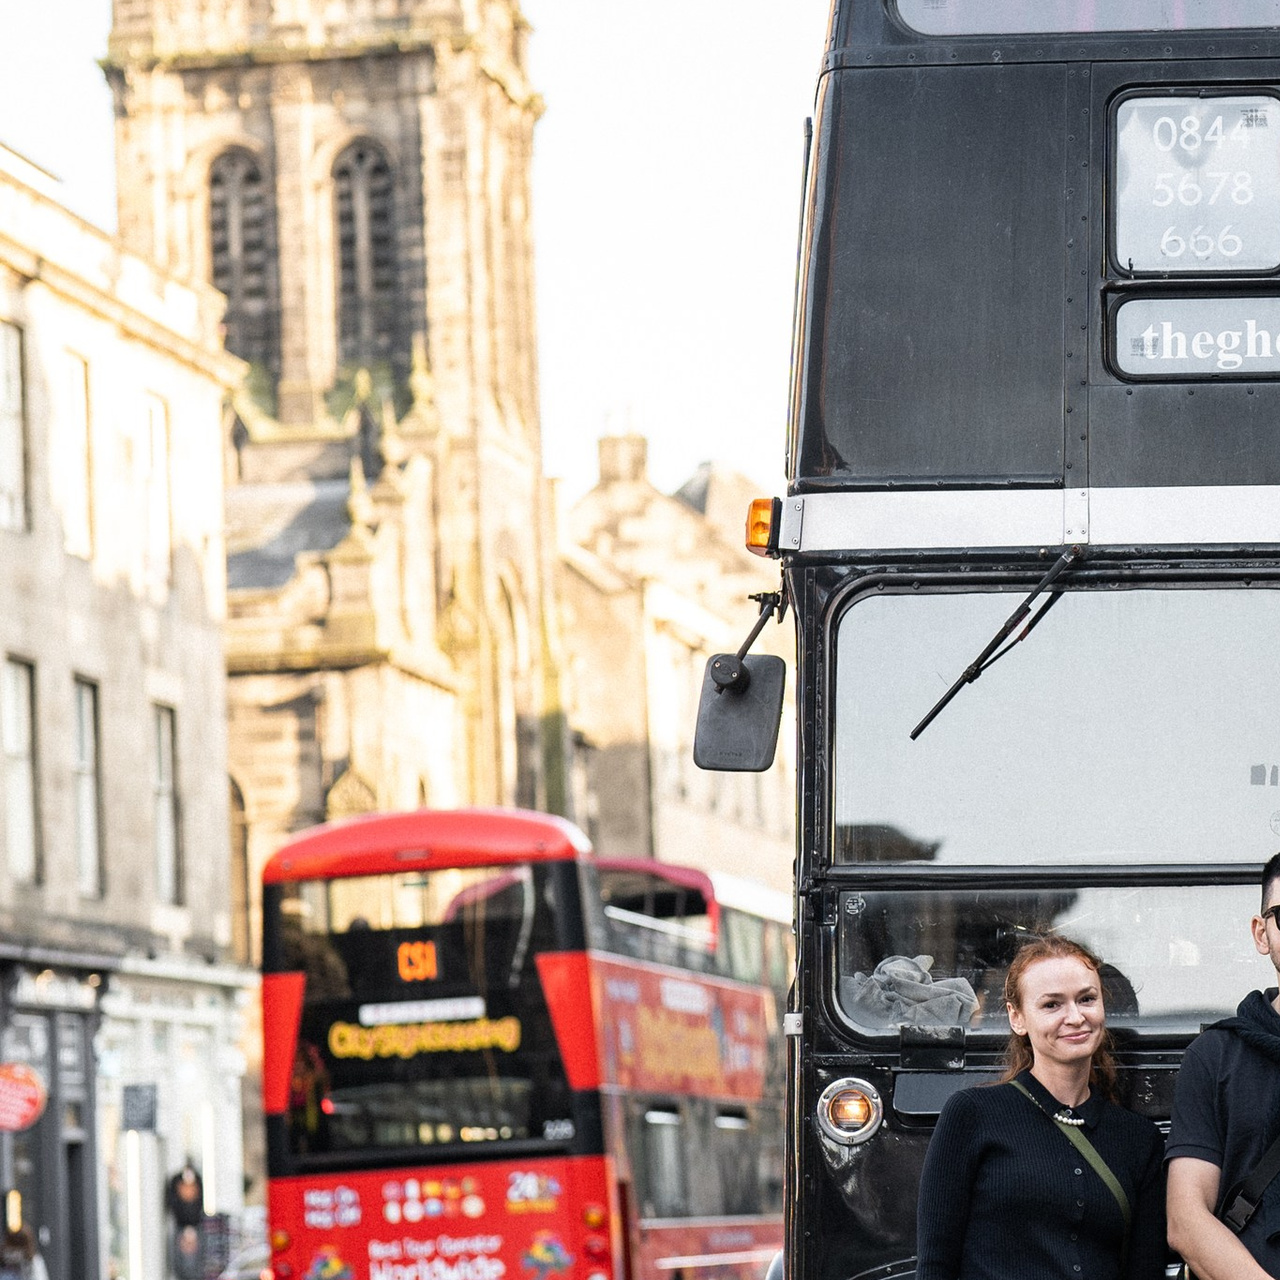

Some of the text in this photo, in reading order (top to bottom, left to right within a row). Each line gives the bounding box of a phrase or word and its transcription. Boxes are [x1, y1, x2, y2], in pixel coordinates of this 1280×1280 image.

[1153, 115, 1251, 152] 0844
[1152, 171, 1254, 207] 5678
[1160, 224, 1243, 258] 666
